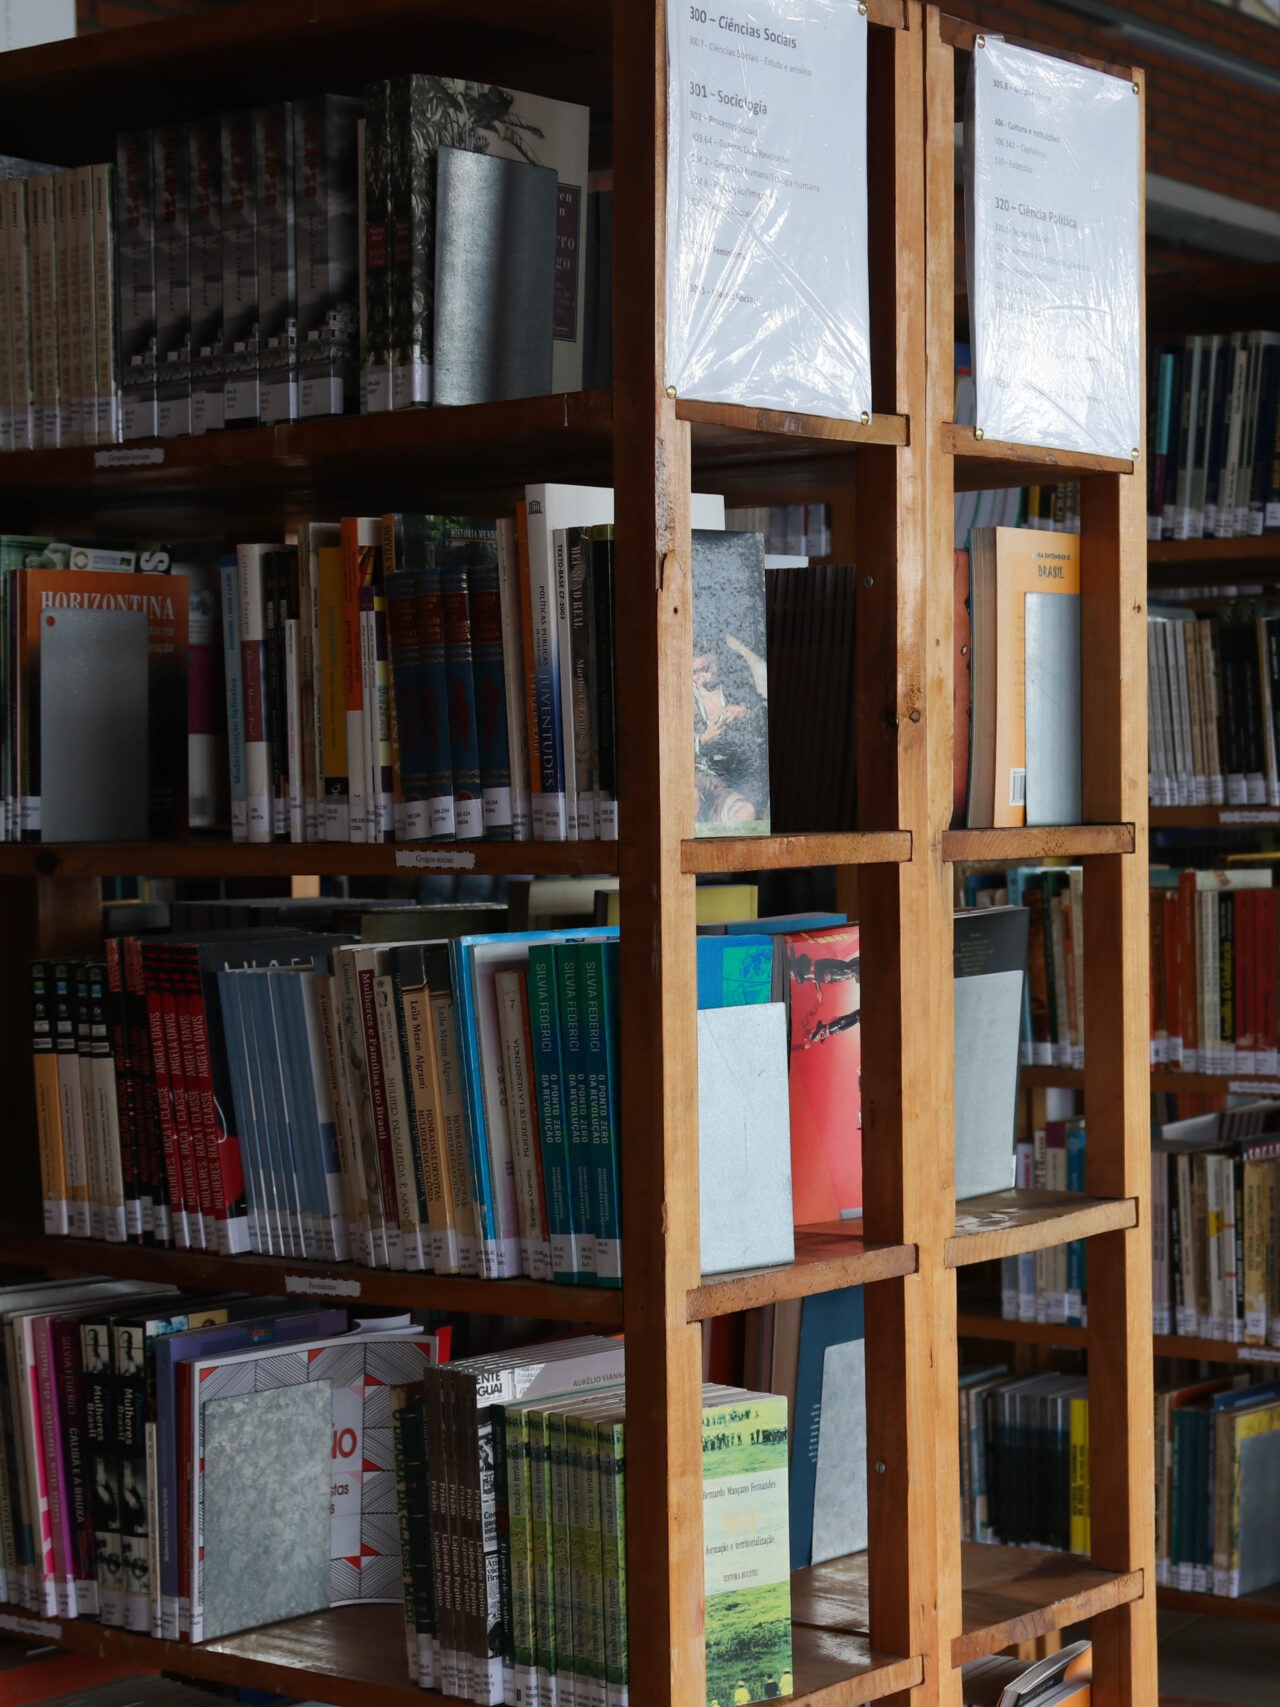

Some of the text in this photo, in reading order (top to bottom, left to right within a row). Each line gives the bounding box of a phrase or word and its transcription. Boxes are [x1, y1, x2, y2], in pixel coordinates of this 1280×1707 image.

[690, 6, 797, 49] 300 Ciências Sociais
[690, 81, 768, 116] 301 Sociologia
[995, 197, 1077, 229] 320 Ciência Política
[1037, 564, 1065, 579] BRASIL
[41, 590, 176, 620] HORIZONTINA
[539, 585, 549, 667] POLÍTICAS PÚBLICAS
[537, 672, 555, 787] JUVENTUDES
[230, 722, 242, 784] Modernização
[361, 971, 374, 1027] Mulheres
[536, 962, 552, 1053] SILVIA FEDERICI
[564, 962, 580, 1052] SILVIA FEDERICI
[585, 961, 600, 1052] SILVIA FEDERICI
[148, 1011, 165, 1074] ANGELA DAVIS
[164, 1013, 182, 1075] ANGELA DAVIS
[192, 1015, 209, 1078] ANGELA DAVIS
[369, 1038, 382, 1087] Famílias
[409, 1001, 428, 1090] Leila Mezan Algranti
[437, 1006, 455, 1095] Leila Mezan Algranti
[512, 1038, 524, 1093] RESISTENCIA
[158, 1088, 171, 1121] CLASSE
[174, 1088, 187, 1120] CLASSE
[202, 1090, 215, 1125] CLASSE
[374, 1089, 383, 1103] no
[541, 1074, 553, 1144] DA REVOLUÇÃO
[550, 1084, 560, 1116] PONTO
[568, 1074, 580, 1144] DA REVOLUÇÃO
[578, 1084, 587, 1116] PONTO
[588, 1074, 600, 1145] DA REVOLUÇÃO
[598, 1084, 608, 1116] PONTO
[376, 1106, 388, 1140] Brasil
[425, 1109, 437, 1153] HONRADAS
[552, 1119, 562, 1144] ZERO
[580, 1118, 588, 1144] ZERO
[600, 1119, 609, 1144] ZERO
[417, 1109, 436, 1203] MULHERES DA COLÔNIA
[61, 1335, 72, 1368] SILVIA
[572, 1375, 600, 1388] AURÉLIO
[38, 1331, 61, 1524] Guia dos Direitos da Mulher
[87, 1401, 97, 1439] Brasil
[93, 1385, 105, 1442] Mulheres
[123, 1387, 134, 1445] Mulheres
[73, 1486, 86, 1524] BRUXA
[439, 1482, 447, 1514] Prisão
[449, 1483, 458, 1515] Prisão
[466, 1488, 474, 1520] Prisão
[474, 1489, 482, 1521] Prisão
[750, 1479, 776, 1492] Fernandes
[721, 1506, 760, 1537] MST
[705, 1543, 729, 1555] formação
[441, 1533, 453, 1609] Lajeado Pepino
[451, 1535, 463, 1611] Lajeado Pepino
[467, 1539, 478, 1616] Lajeado Pepino
[476, 1540, 486, 1618] Lajeado Pepino
